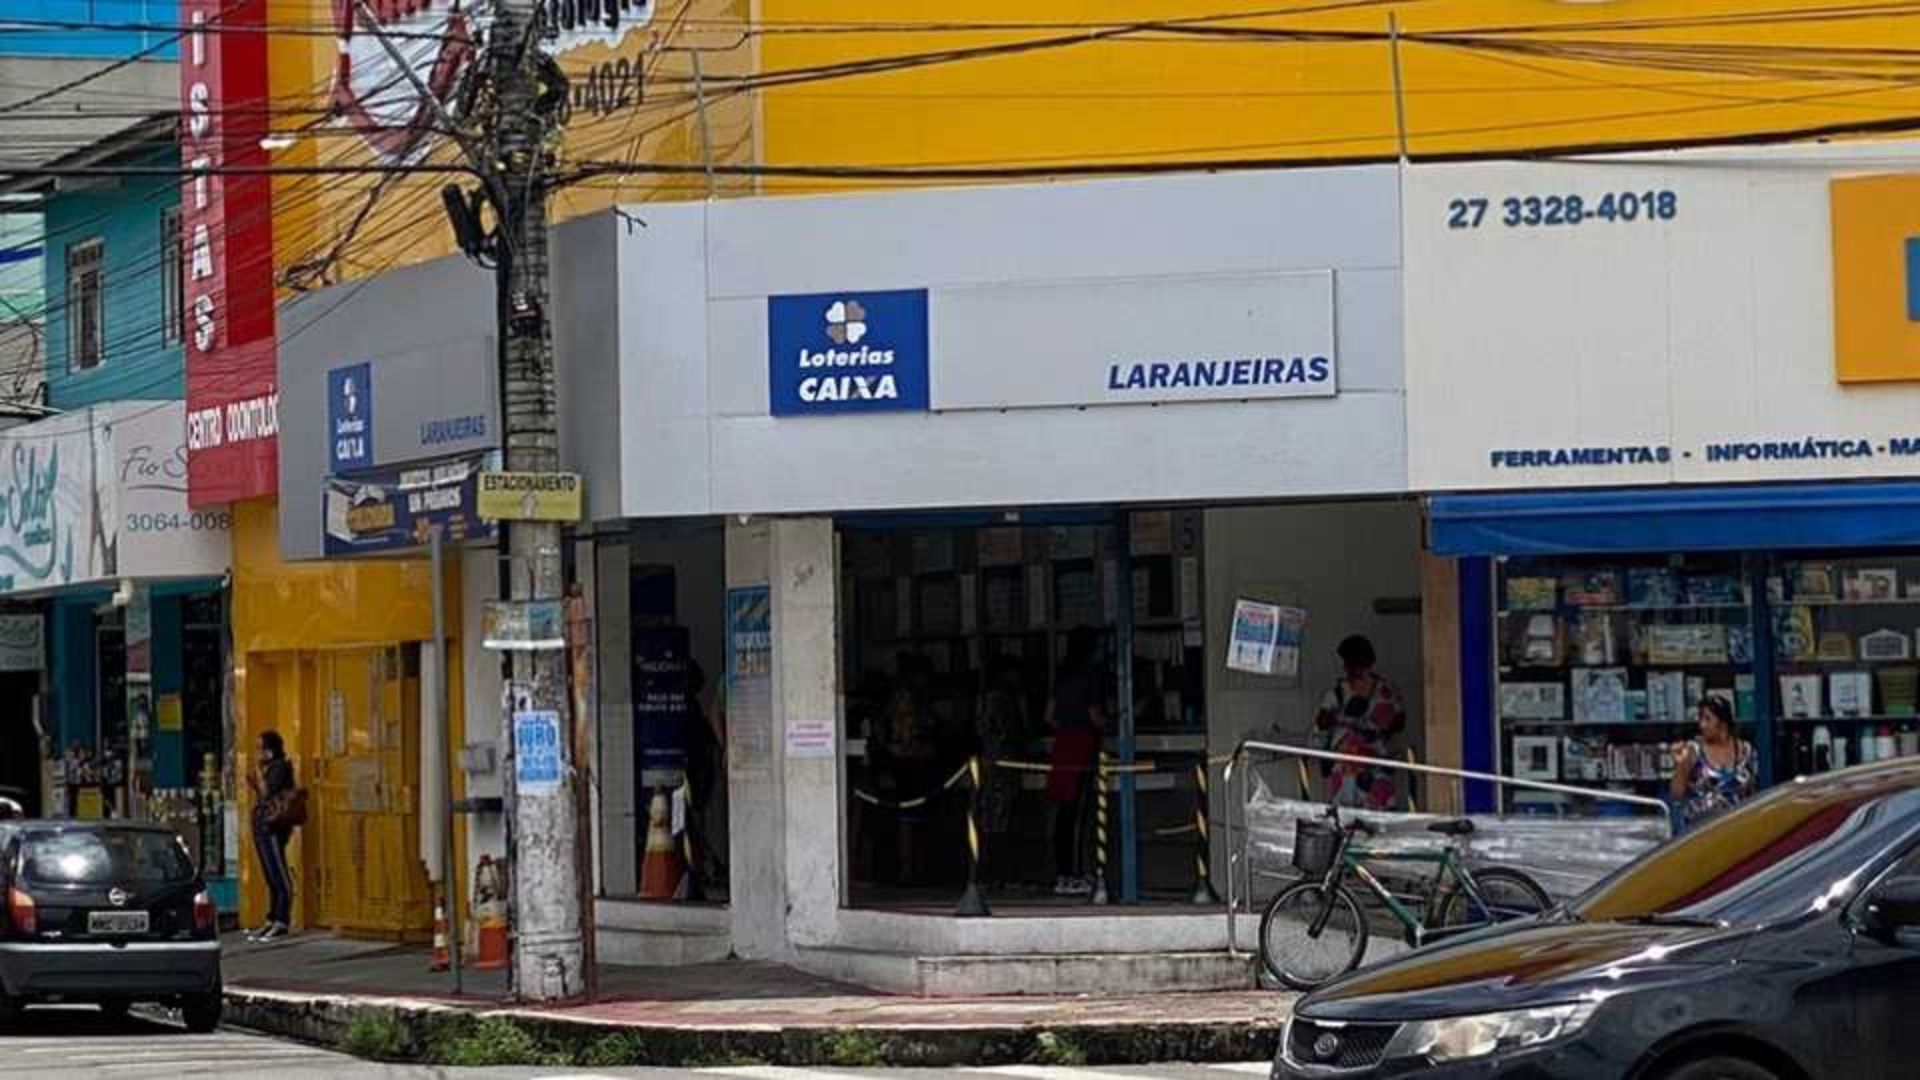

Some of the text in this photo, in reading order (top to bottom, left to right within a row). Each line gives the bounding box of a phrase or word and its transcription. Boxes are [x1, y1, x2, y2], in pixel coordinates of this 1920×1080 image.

[1448, 190, 1677, 228] 27 3328-4018
[800, 345, 895, 368] Loterias
[799, 374, 898, 402] CAIXA
[1108, 356, 1329, 390] LARANJEIRAS
[188, 406, 222, 450] CENTRO
[1490, 446, 1671, 468] FERRAMENTAS
[1706, 437, 1873, 462] INFORMÁTICA
[484, 474, 577, 492] ESTACIONAMENTO
